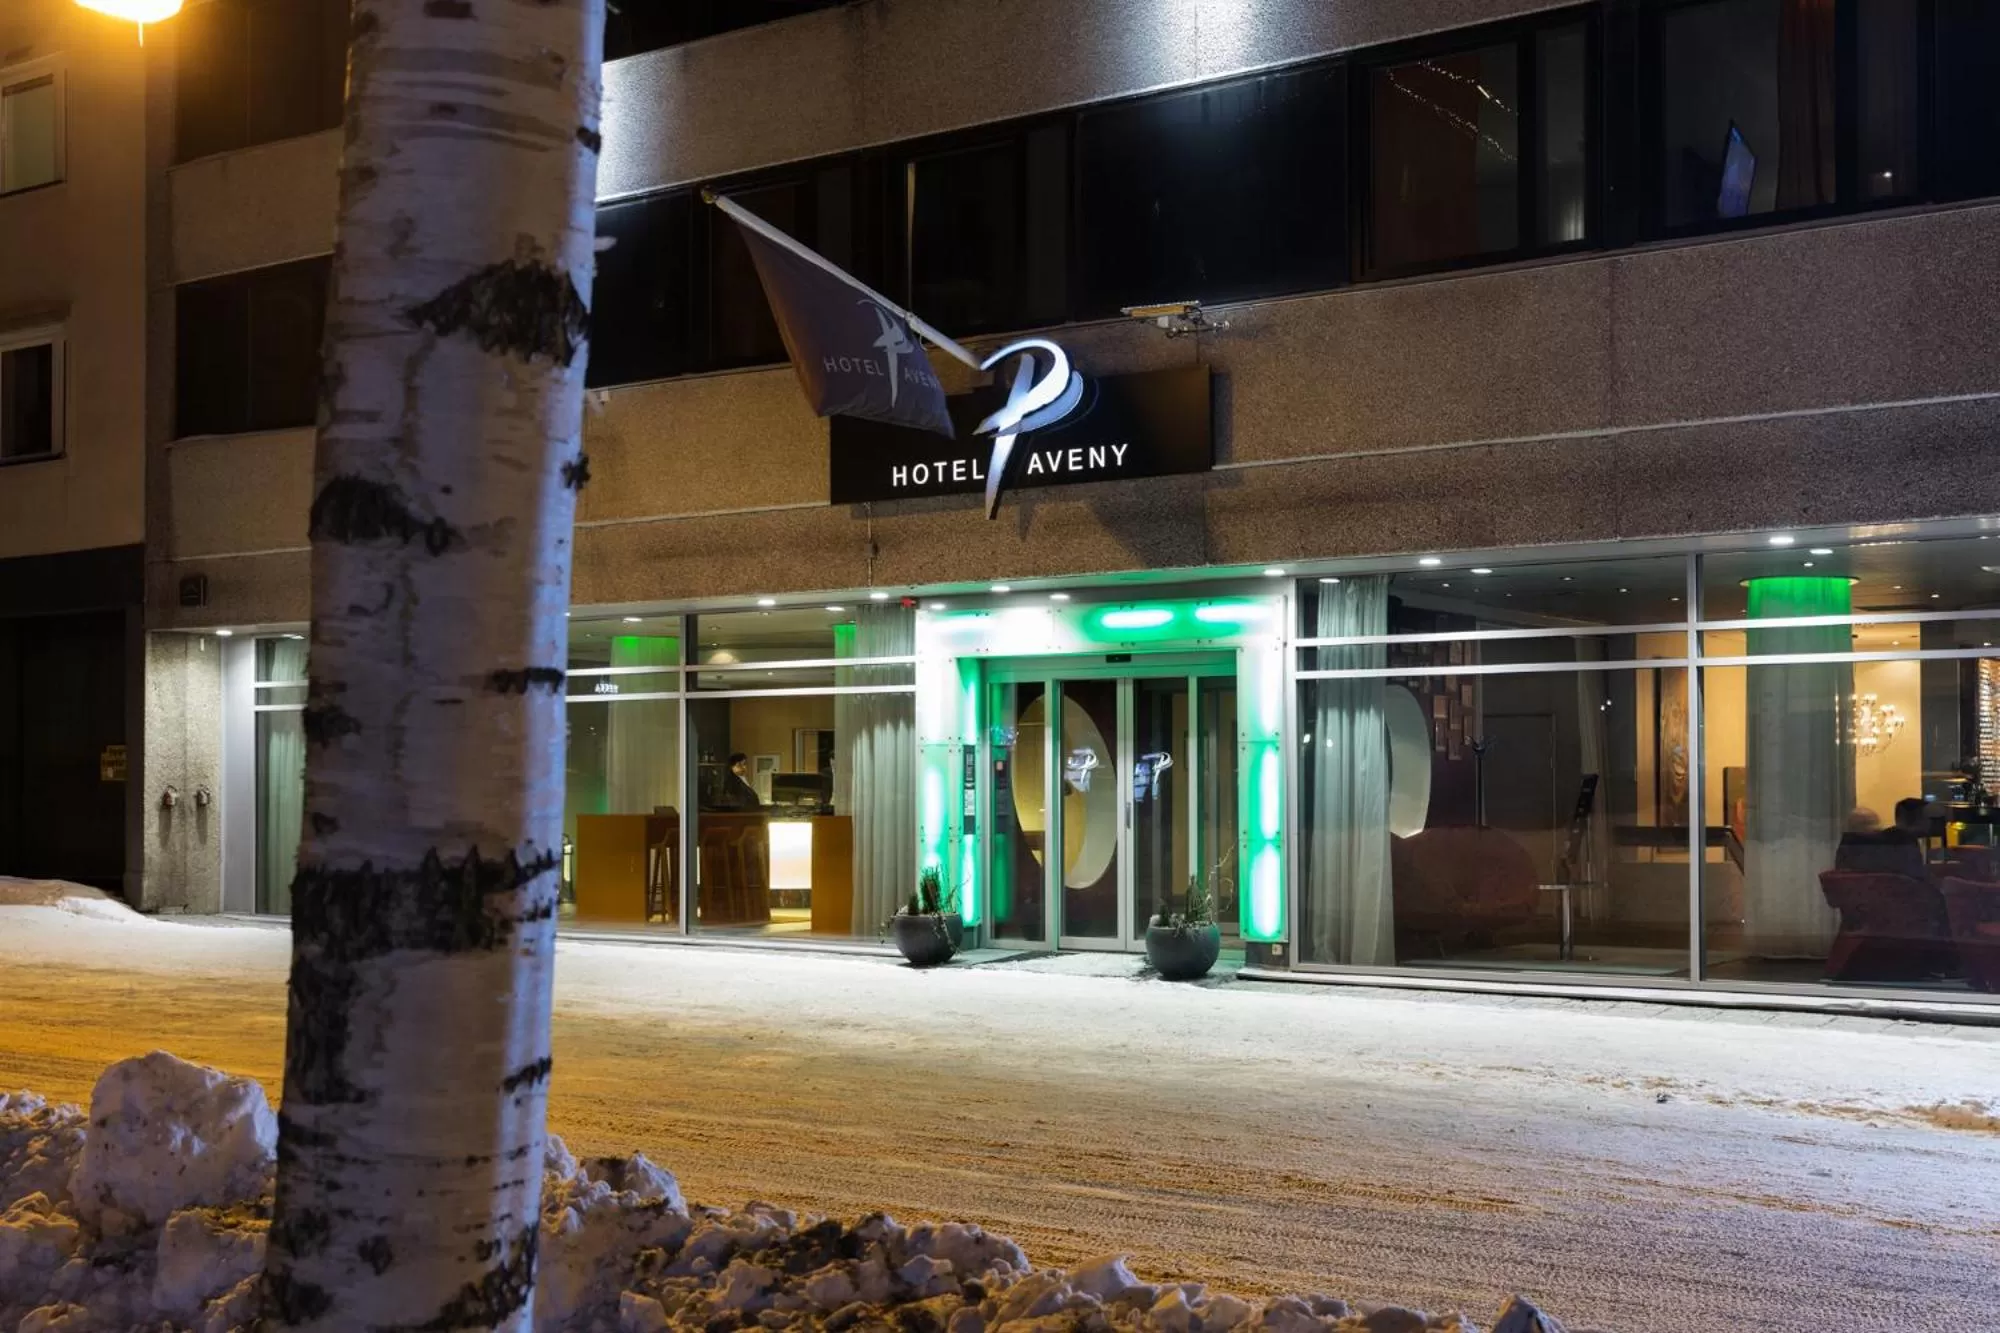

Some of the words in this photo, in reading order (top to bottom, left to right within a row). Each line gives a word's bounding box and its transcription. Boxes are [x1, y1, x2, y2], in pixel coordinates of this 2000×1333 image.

[823, 356, 884, 376] HOTEL
[904, 367, 938, 389] AVEN
[893, 459, 984, 486] HOTEL
[1027, 443, 1128, 474] AVENY
